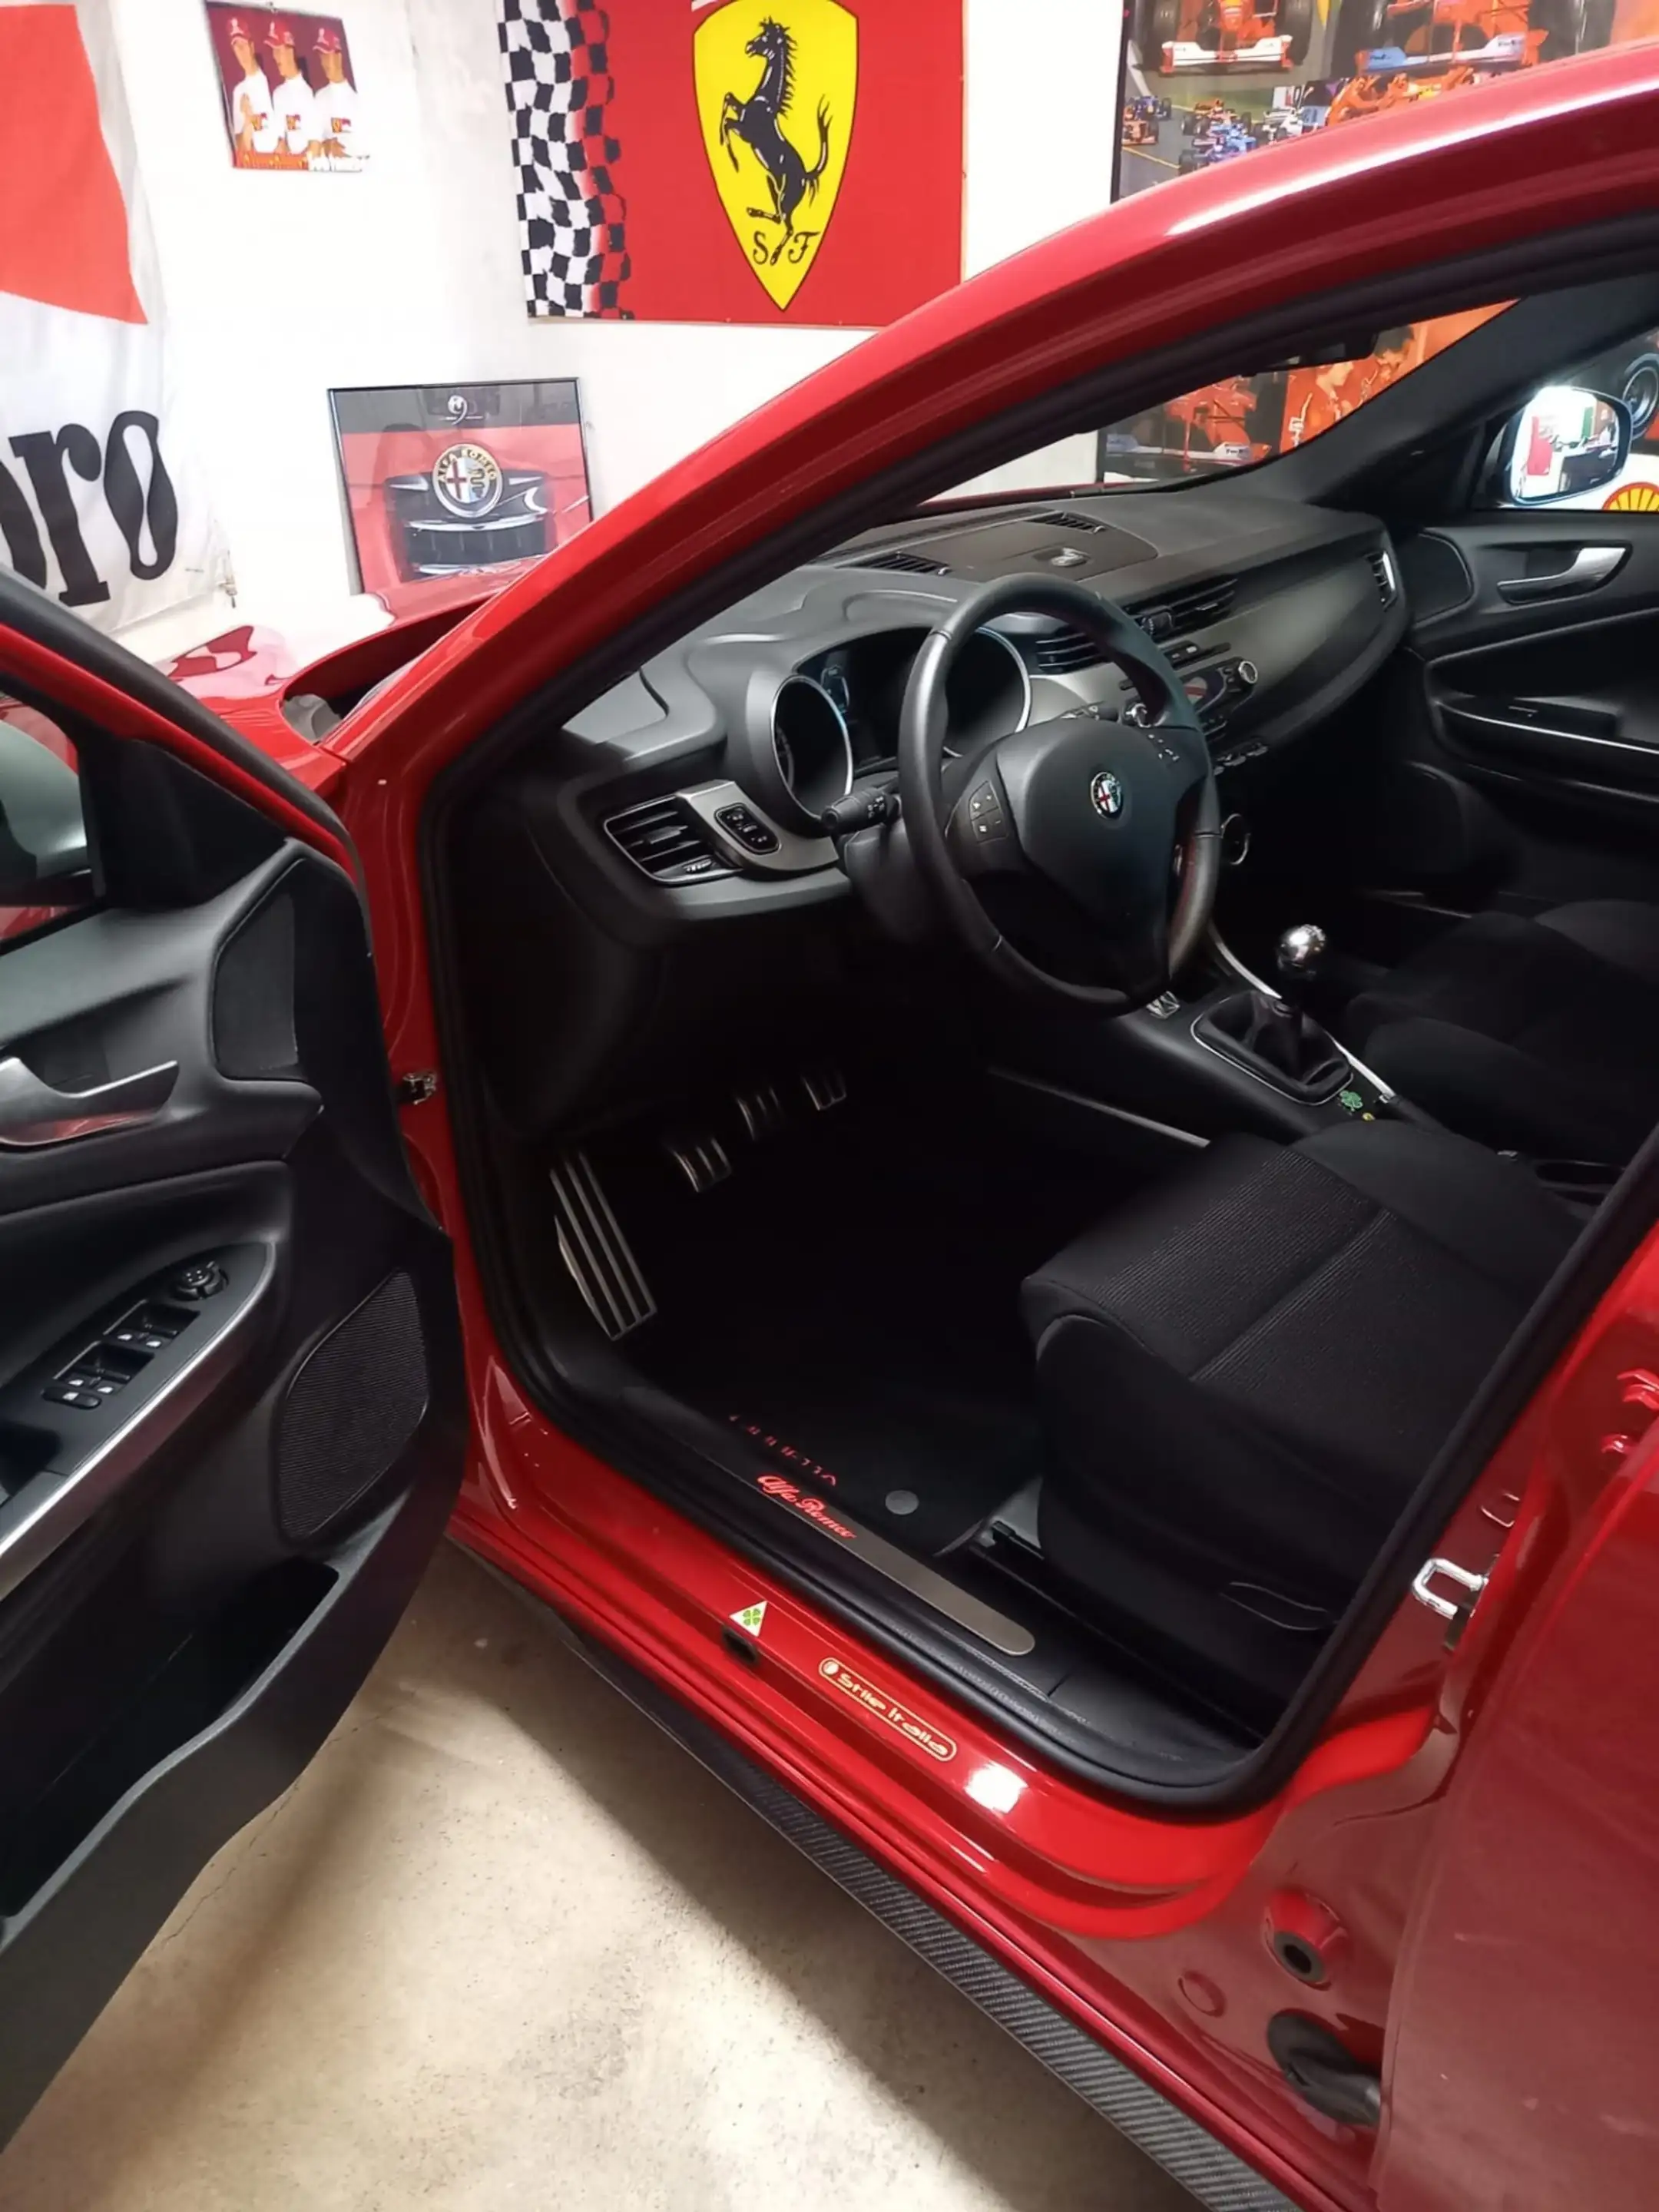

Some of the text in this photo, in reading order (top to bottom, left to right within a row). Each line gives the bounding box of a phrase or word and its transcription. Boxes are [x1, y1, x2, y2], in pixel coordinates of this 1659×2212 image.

[753, 230, 768, 265] S
[757, 1475, 857, 1539] Alfa Romeo
